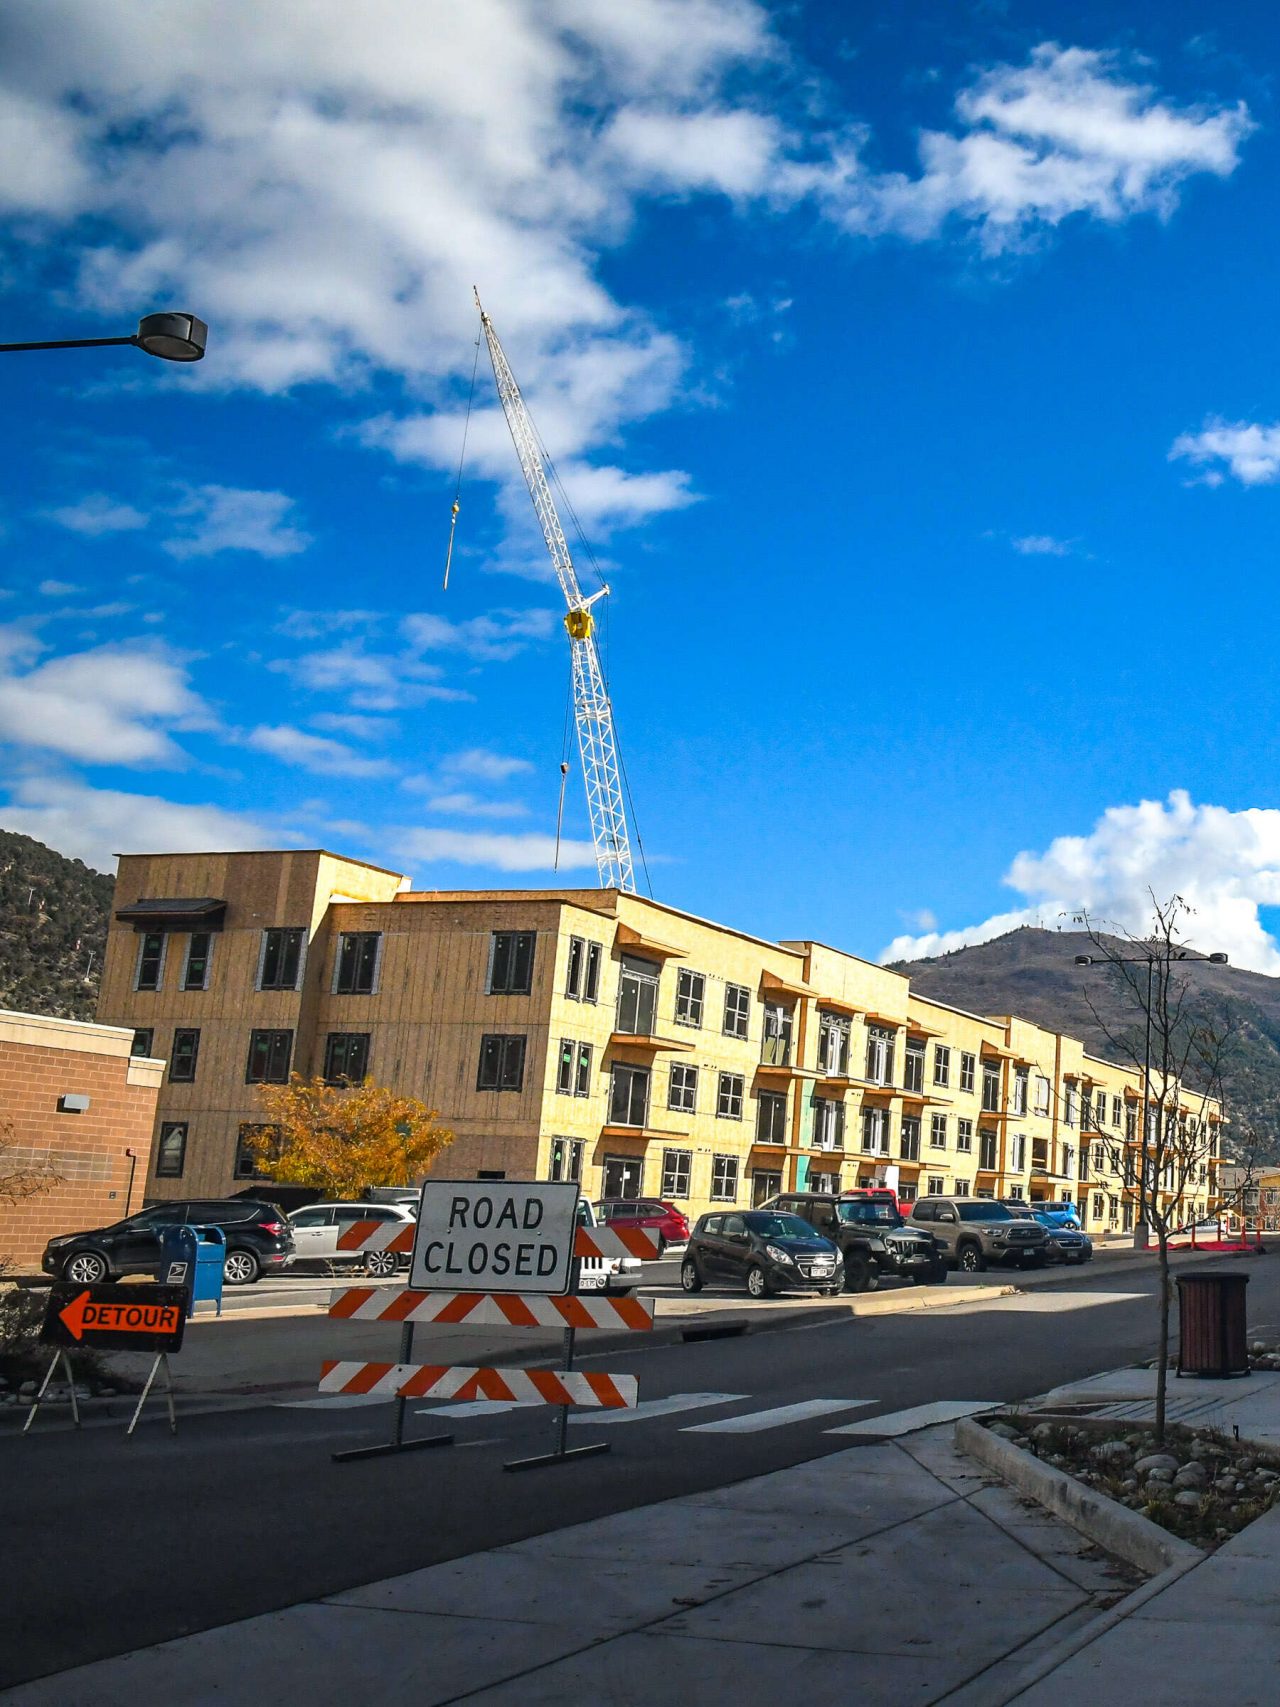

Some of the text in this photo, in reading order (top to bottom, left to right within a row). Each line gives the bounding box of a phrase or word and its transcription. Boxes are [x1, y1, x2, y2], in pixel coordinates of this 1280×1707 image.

[449, 1196, 544, 1230] ROAD
[424, 1241, 558, 1276] CLOSED
[82, 1306, 175, 1328] DETOUR
